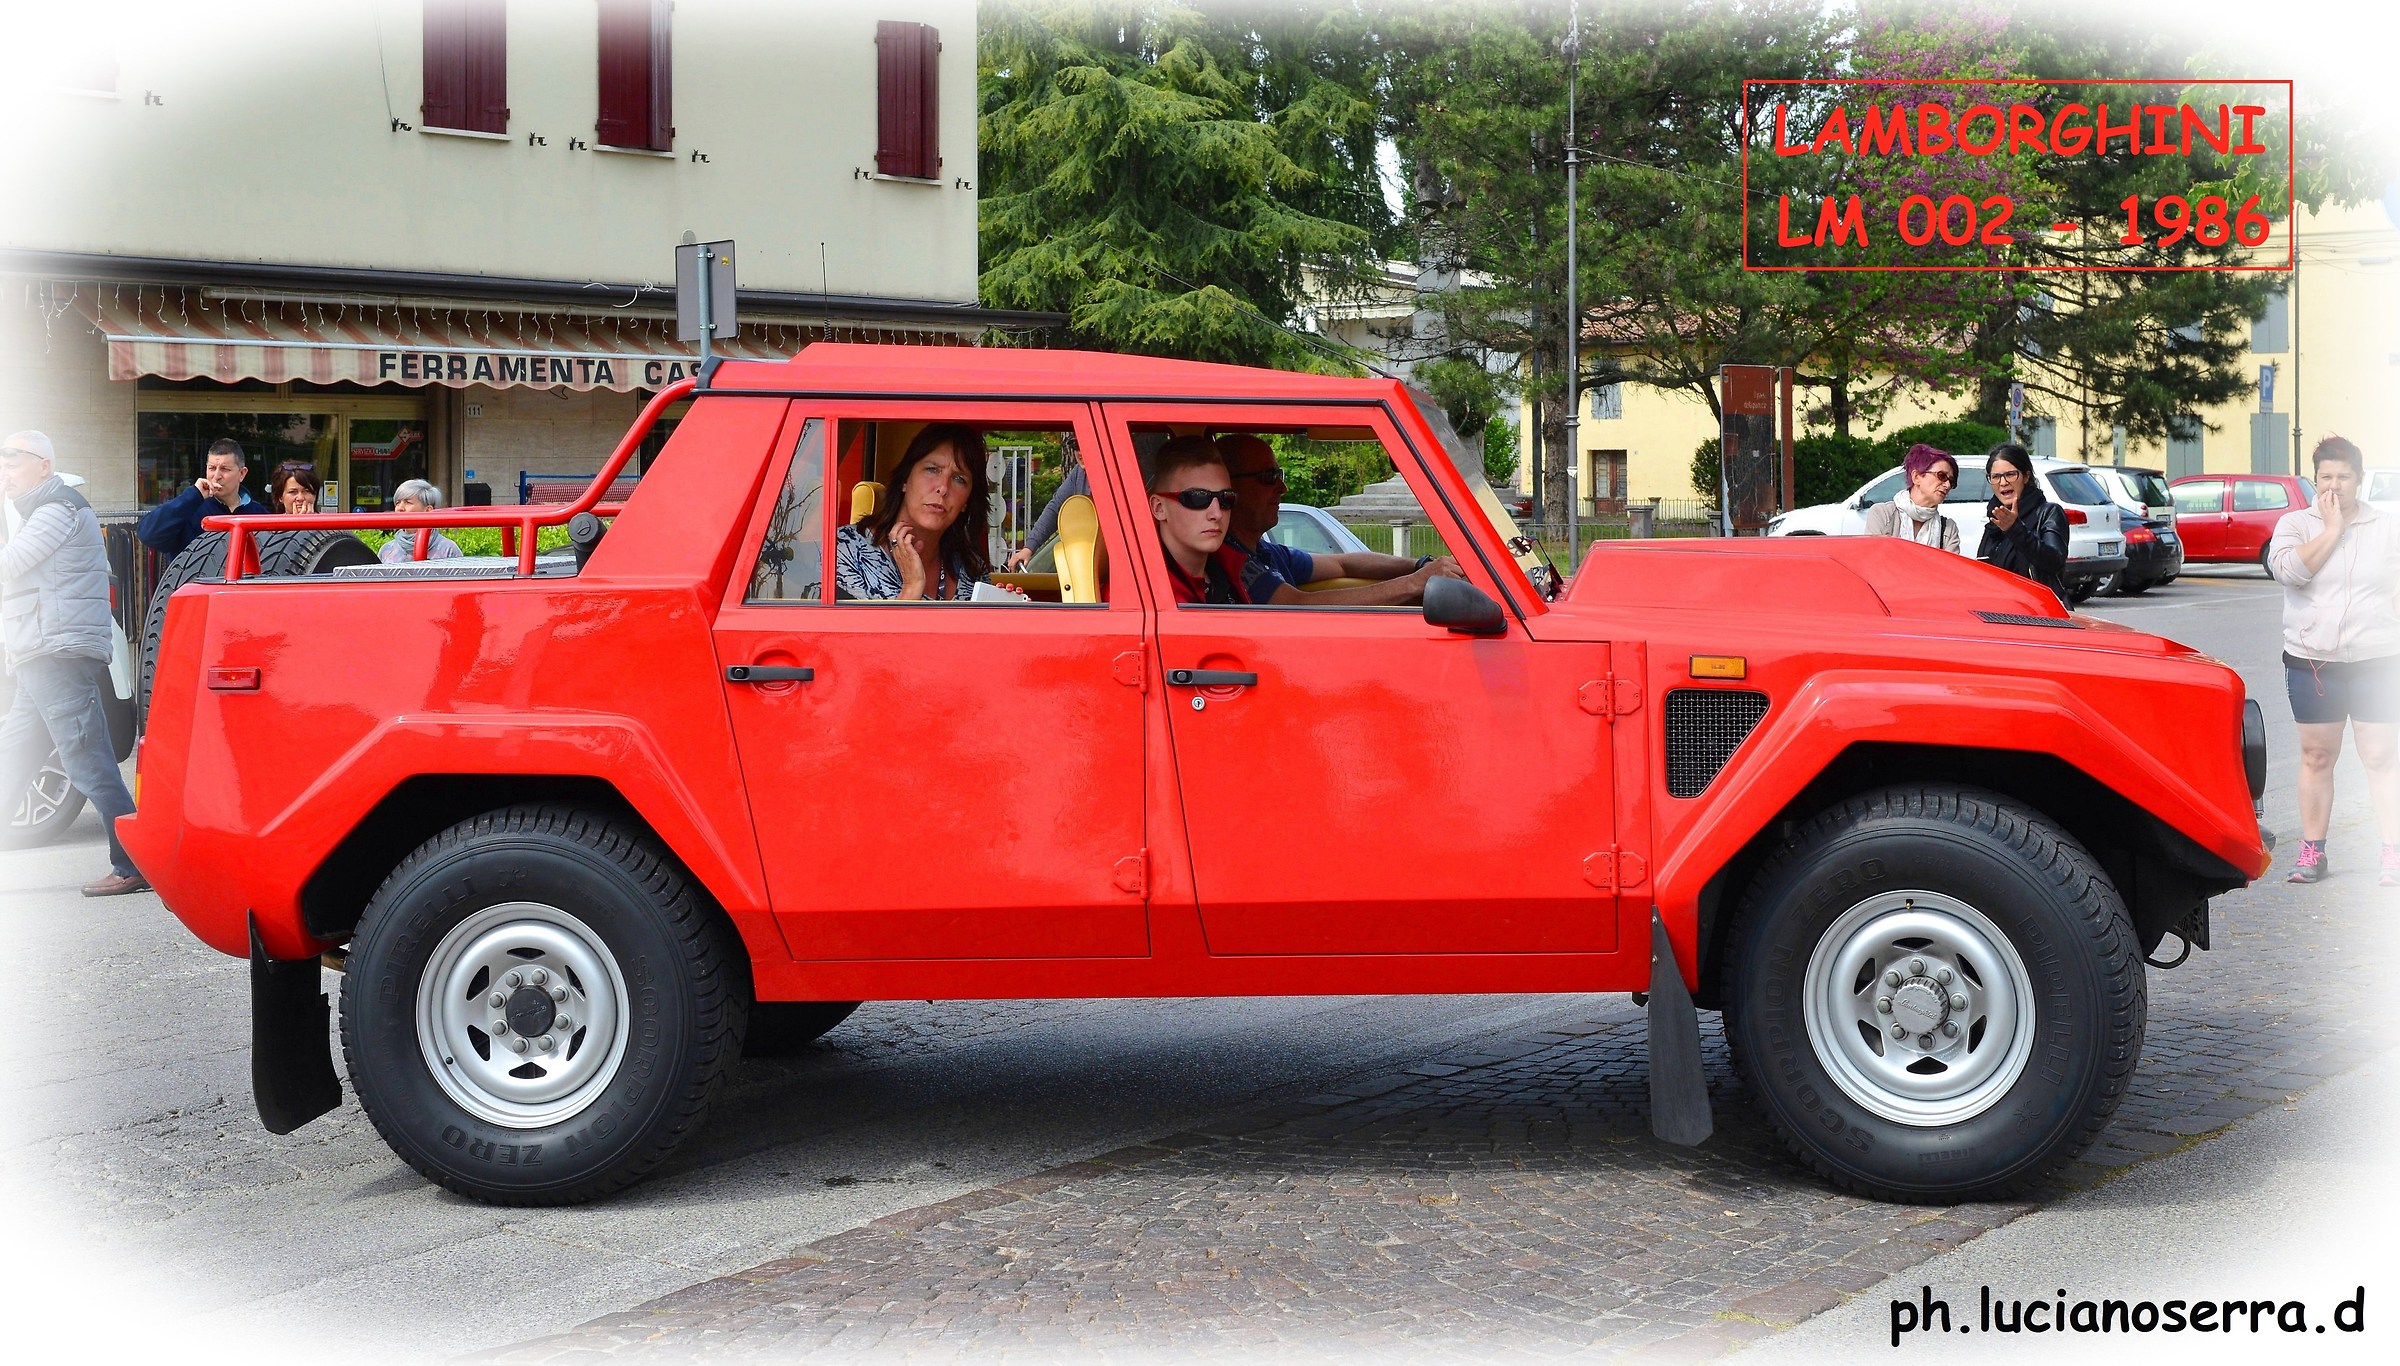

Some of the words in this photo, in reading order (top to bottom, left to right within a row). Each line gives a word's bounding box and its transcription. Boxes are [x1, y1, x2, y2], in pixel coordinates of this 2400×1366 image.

[379, 353, 615, 385] FERRAMENTA
[2262, 368, 2272, 398] P
[468, 406, 481, 416] 111
[1789, 856, 1889, 930] ZERO
[378, 876, 476, 1006] PIRELLI
[2015, 914, 2074, 1087] PIRELLI
[564, 954, 662, 1159] SCORPION
[1764, 944, 1877, 1154] SCORPION
[440, 1124, 544, 1168] ZERO
